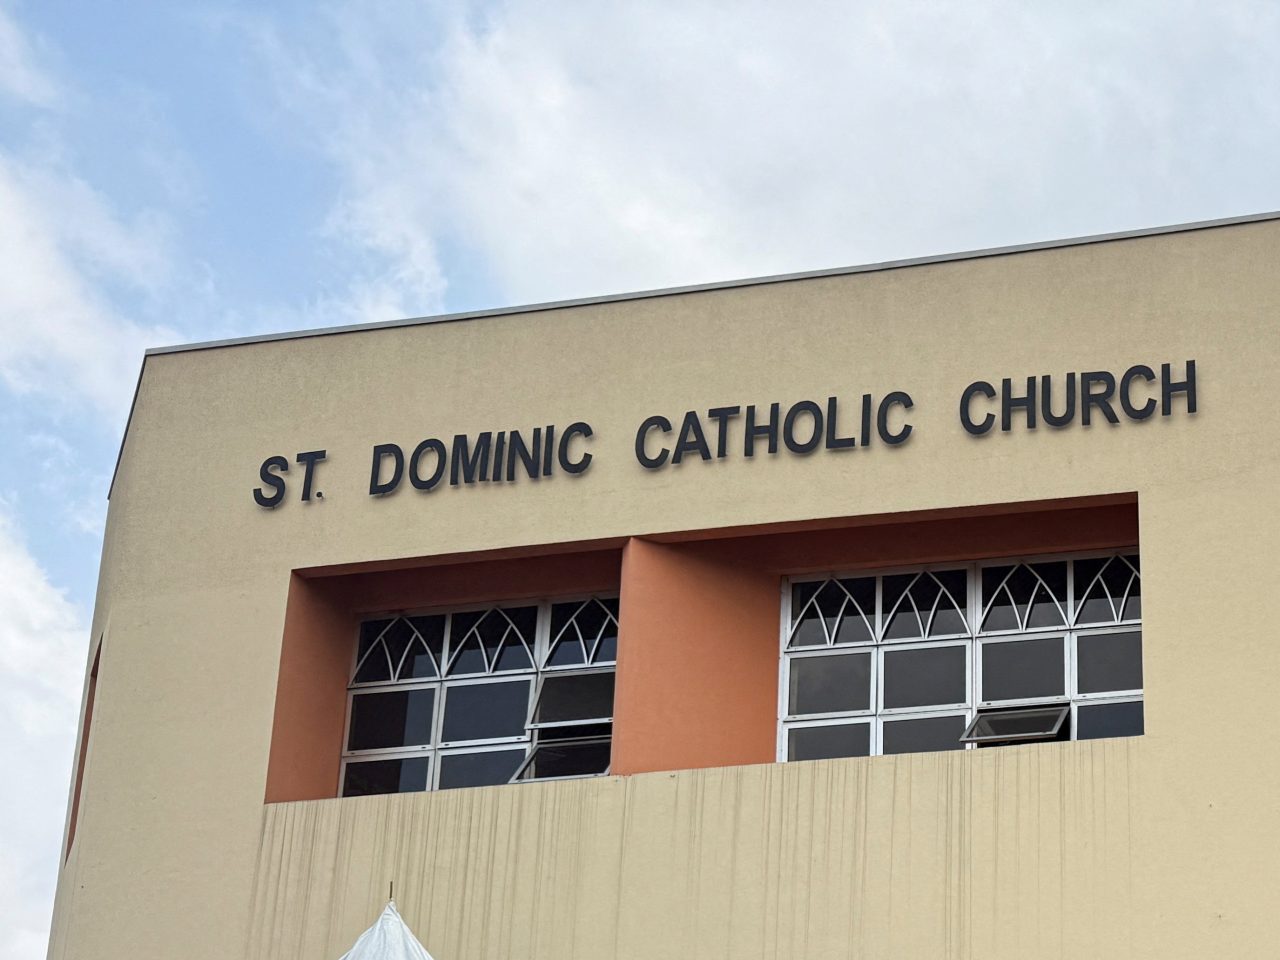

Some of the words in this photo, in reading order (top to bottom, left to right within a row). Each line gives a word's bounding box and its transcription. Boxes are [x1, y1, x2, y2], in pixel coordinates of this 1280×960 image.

[253, 449, 327, 508] ST.
[369, 421, 593, 497] DOMINIC
[635, 391, 914, 470] CATHOLIC
[960, 360, 1197, 435] CHURCH
